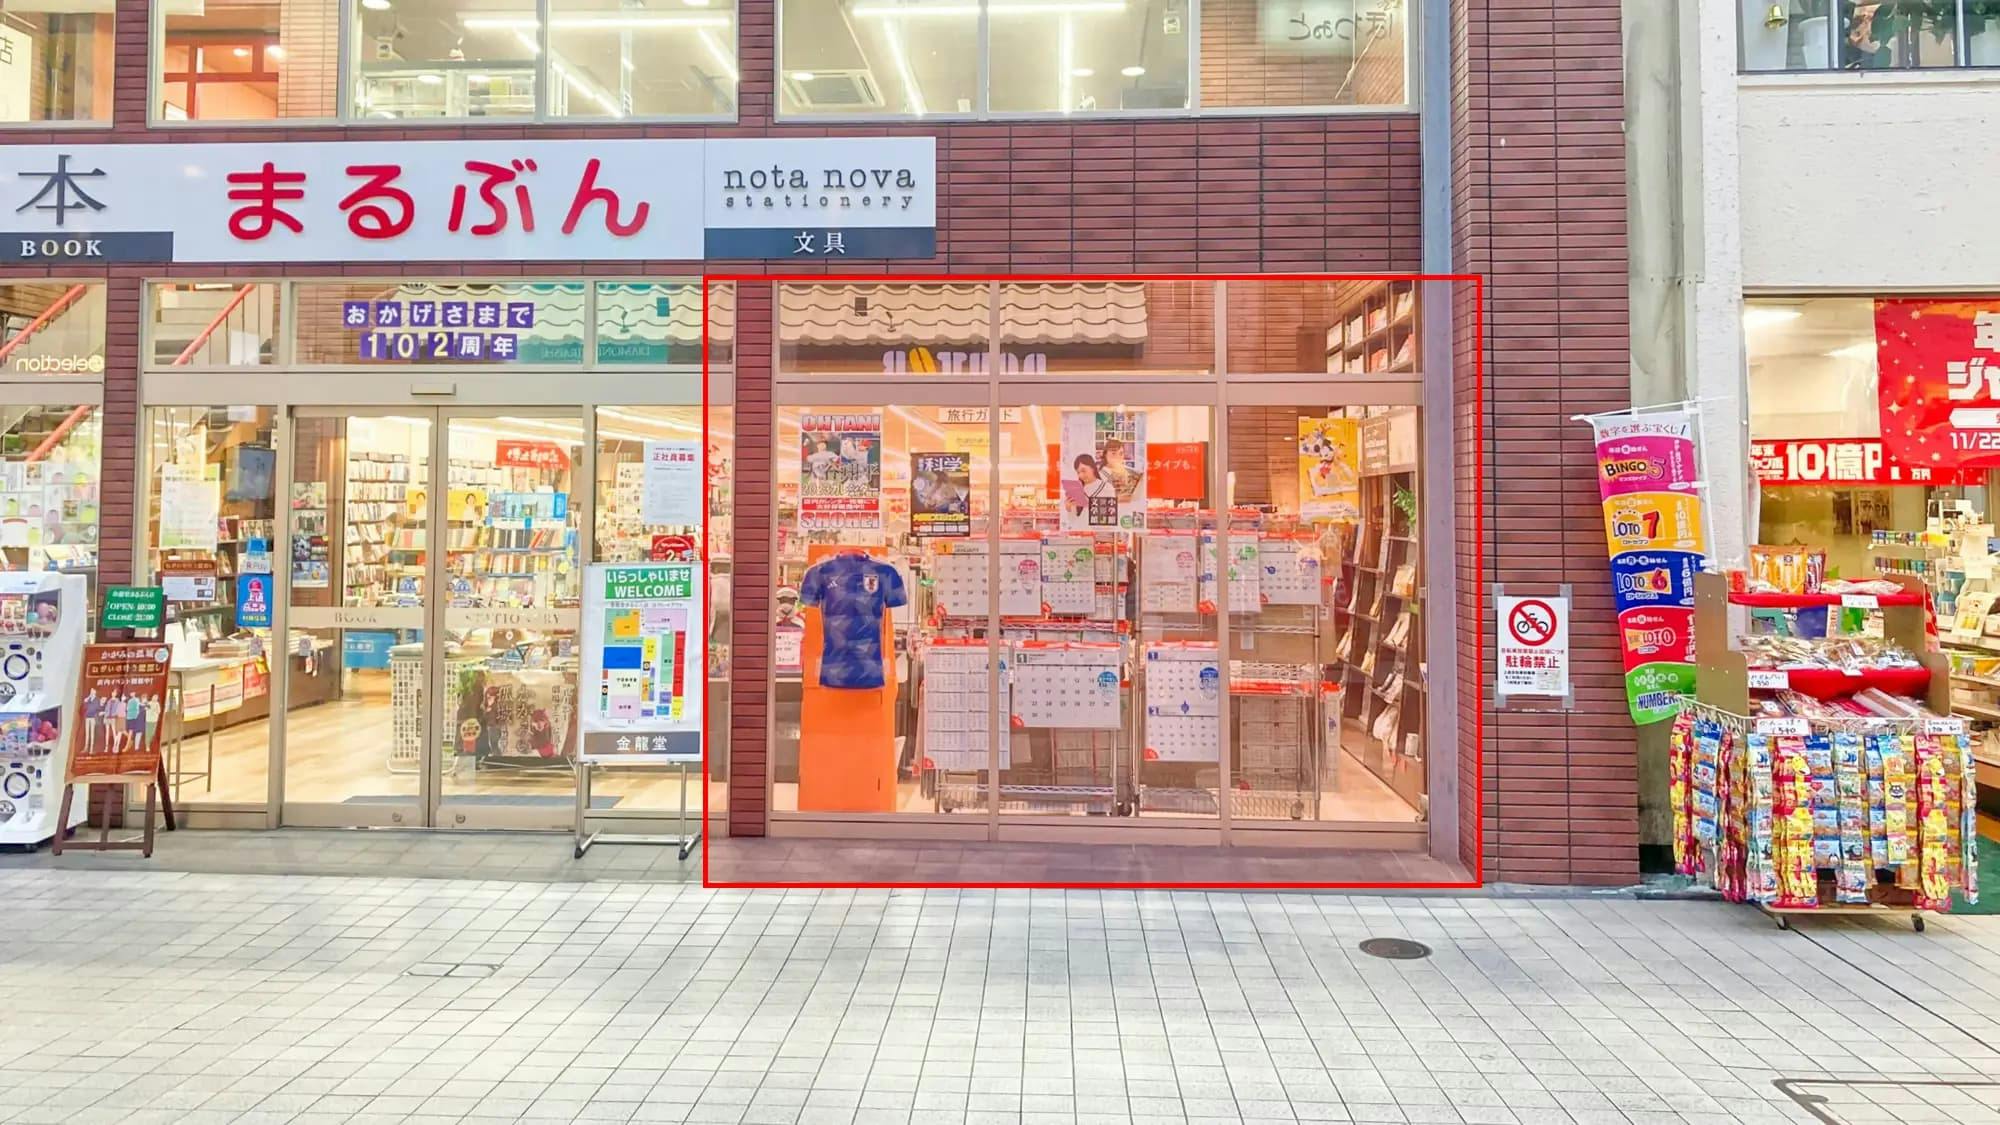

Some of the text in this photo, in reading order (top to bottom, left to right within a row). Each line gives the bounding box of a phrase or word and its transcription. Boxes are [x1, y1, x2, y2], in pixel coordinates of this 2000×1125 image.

[724, 164, 917, 190] nota nova
[15, 153, 108, 227] 本
[226, 158, 651, 241] まるぶん
[725, 193, 914, 210] stationery
[20, 239, 104, 257] BOOK
[792, 231, 847, 255] 文具
[345, 304, 532, 327] おかげさまで
[366, 334, 516, 360] 102周年
[802, 415, 880, 432] OHTANI
[947, 408, 1013, 422] 旅行ガド
[652, 452, 696, 462] 正社員募集
[1604, 460, 1647, 477] BINGO
[1647, 455, 1667, 480] 5
[801, 511, 880, 529] SHOHEI
[1612, 521, 1641, 538] LOTO
[1642, 510, 1660, 540] 7
[606, 569, 690, 583] いらっしゃいませ
[1617, 568, 1668, 592] LOTO 6
[613, 584, 684, 598] WELCOME
[109, 602, 135, 610] OPEN
[107, 613, 133, 621] CLOSE
[1642, 628, 1675, 645] LOTO
[1505, 655, 1561, 669] 駐輪禁止
[1638, 689, 1682, 709] NUMBER
[615, 735, 669, 752] 金龍堂
